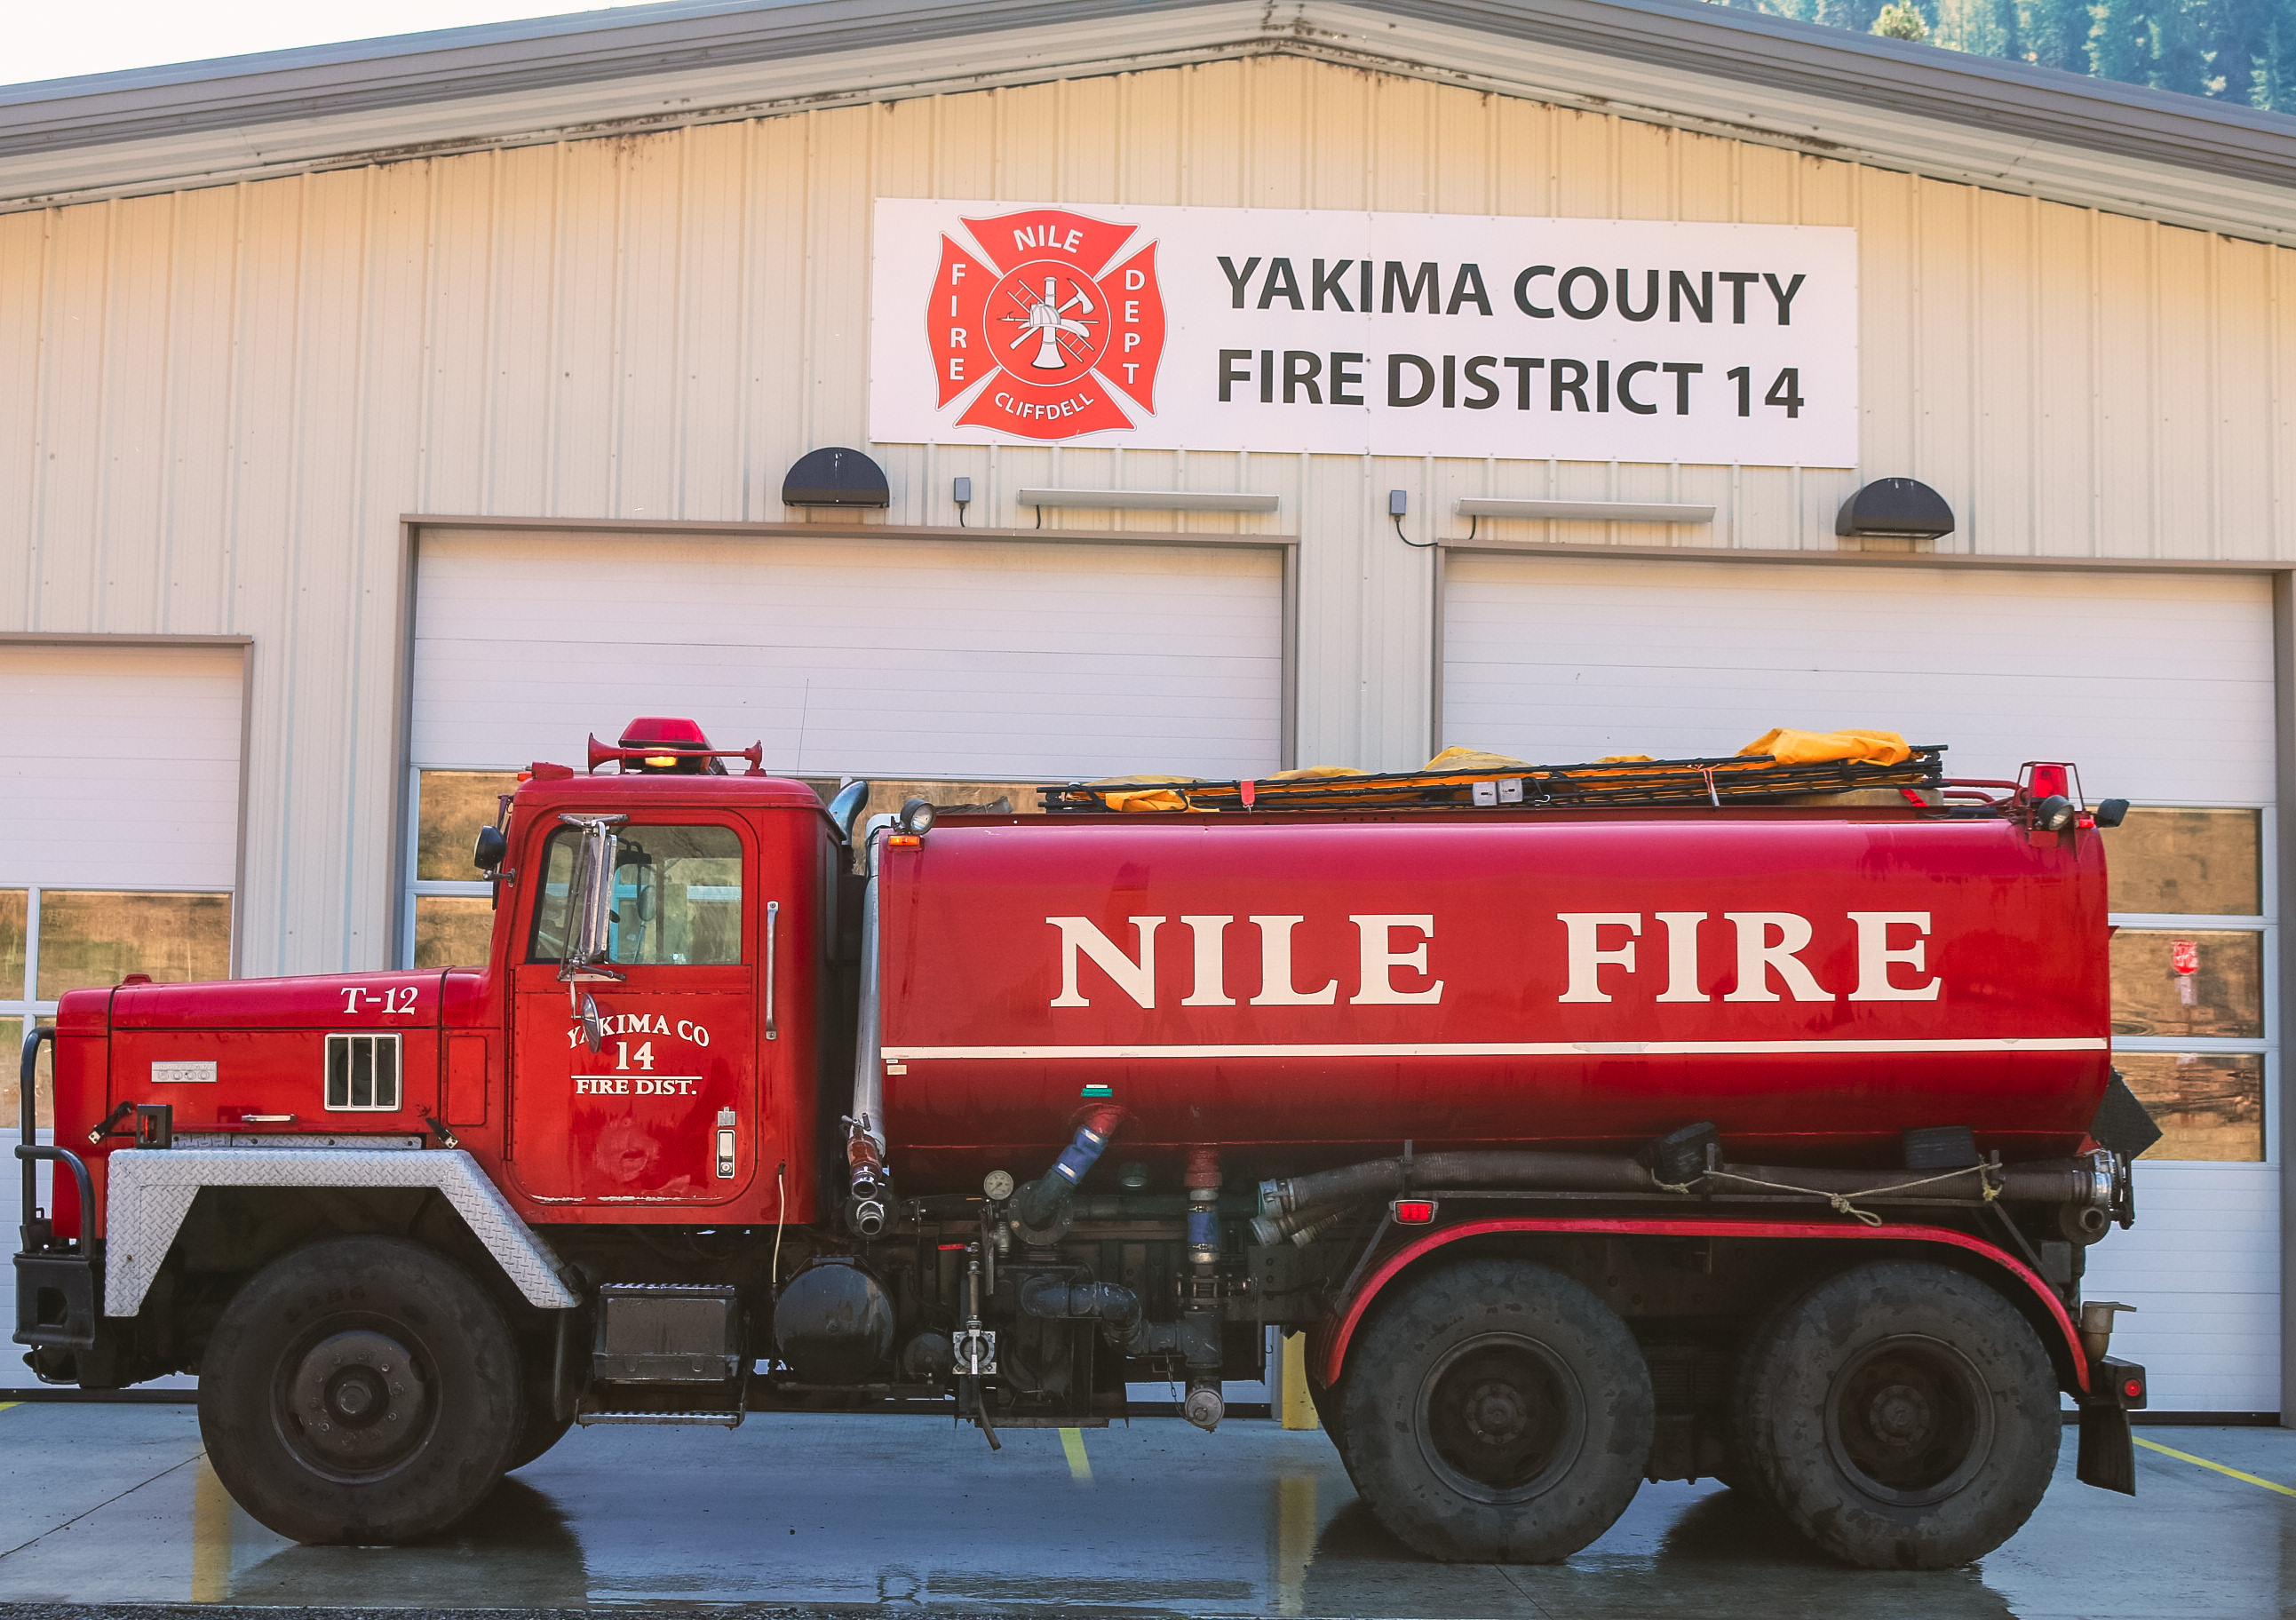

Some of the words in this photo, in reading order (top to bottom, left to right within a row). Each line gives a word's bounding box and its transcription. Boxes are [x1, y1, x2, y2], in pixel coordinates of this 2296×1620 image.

[1013, 225, 1084, 254] NILE
[1217, 256, 1493, 316] YAKIMA
[1513, 265, 1807, 326] COUNTY
[949, 263, 968, 381] FIRE
[1122, 268, 1147, 385] DEPT
[1219, 349, 1364, 406] FIRE
[1387, 353, 1704, 416] DISTRICT
[1726, 365, 1805, 418] 14
[994, 391, 1094, 421] CLIFFDELL
[1045, 914, 1444, 1009] NILE
[1556, 911, 1942, 1004] FIRE
[340, 986, 418, 1015] T-12
[677, 1020, 710, 1047] CO
[616, 1041, 655, 1070] 14
[576, 1079, 630, 1094] FIRE
[634, 1079, 697, 1095] DIST.
